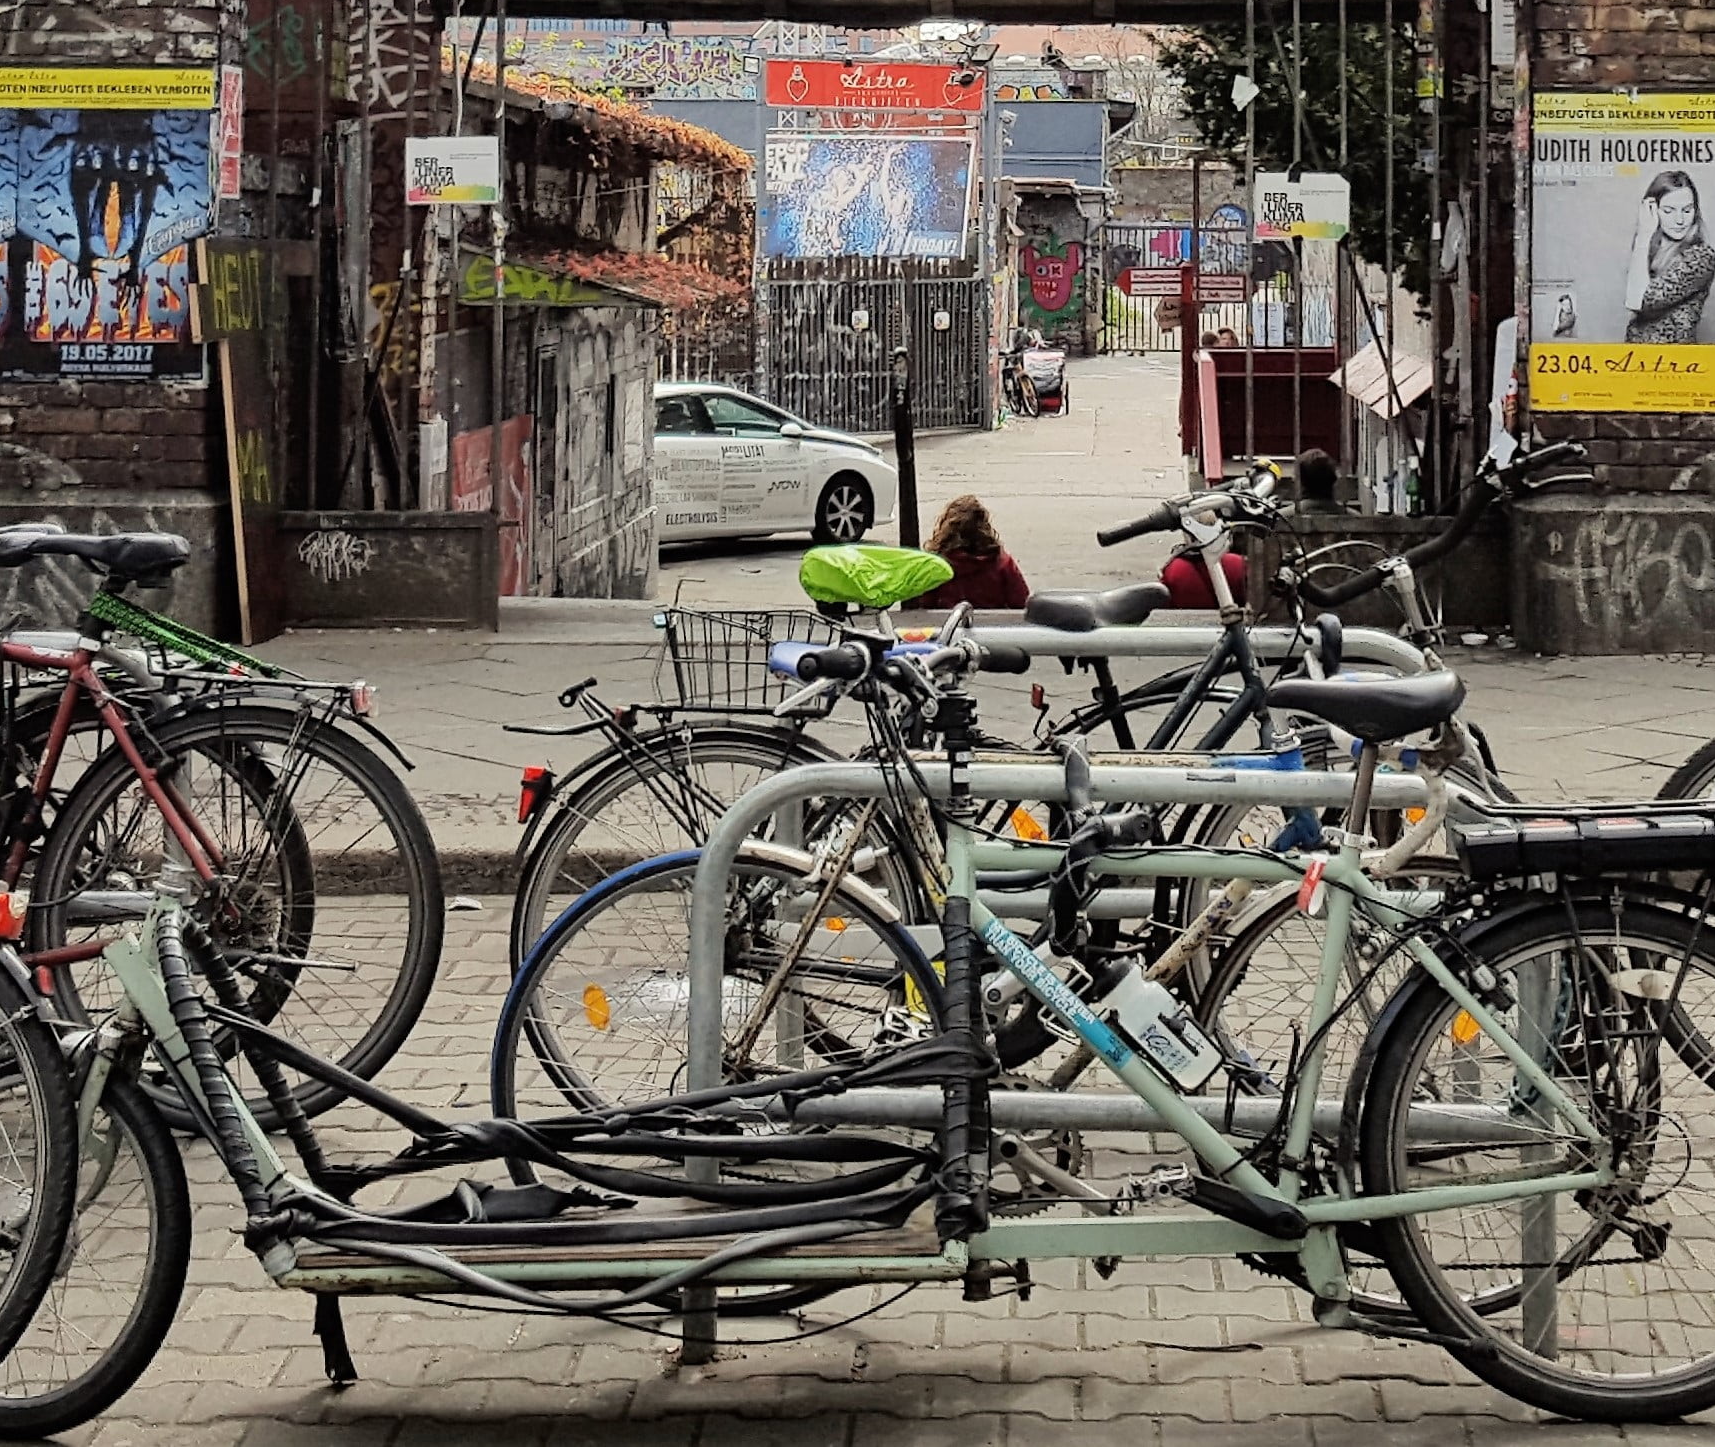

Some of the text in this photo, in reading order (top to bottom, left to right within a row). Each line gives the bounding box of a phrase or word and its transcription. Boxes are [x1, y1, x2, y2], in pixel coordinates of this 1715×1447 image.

[840, 66, 915, 88] Astra
[97, 85, 153, 95] BEKLEBEN
[155, 86, 211, 96] VERBOTEN
[1533, 109, 1605, 120] UNBEFUGTES
[1608, 110, 1665, 120] BEKLEBEN
[1601, 140, 1713, 164] HOLOFERNES
[1264, 192, 1288, 203] BER
[61, 344, 153, 361] 19.05.2017
[1536, 350, 1709, 374] 23.04. Astra
